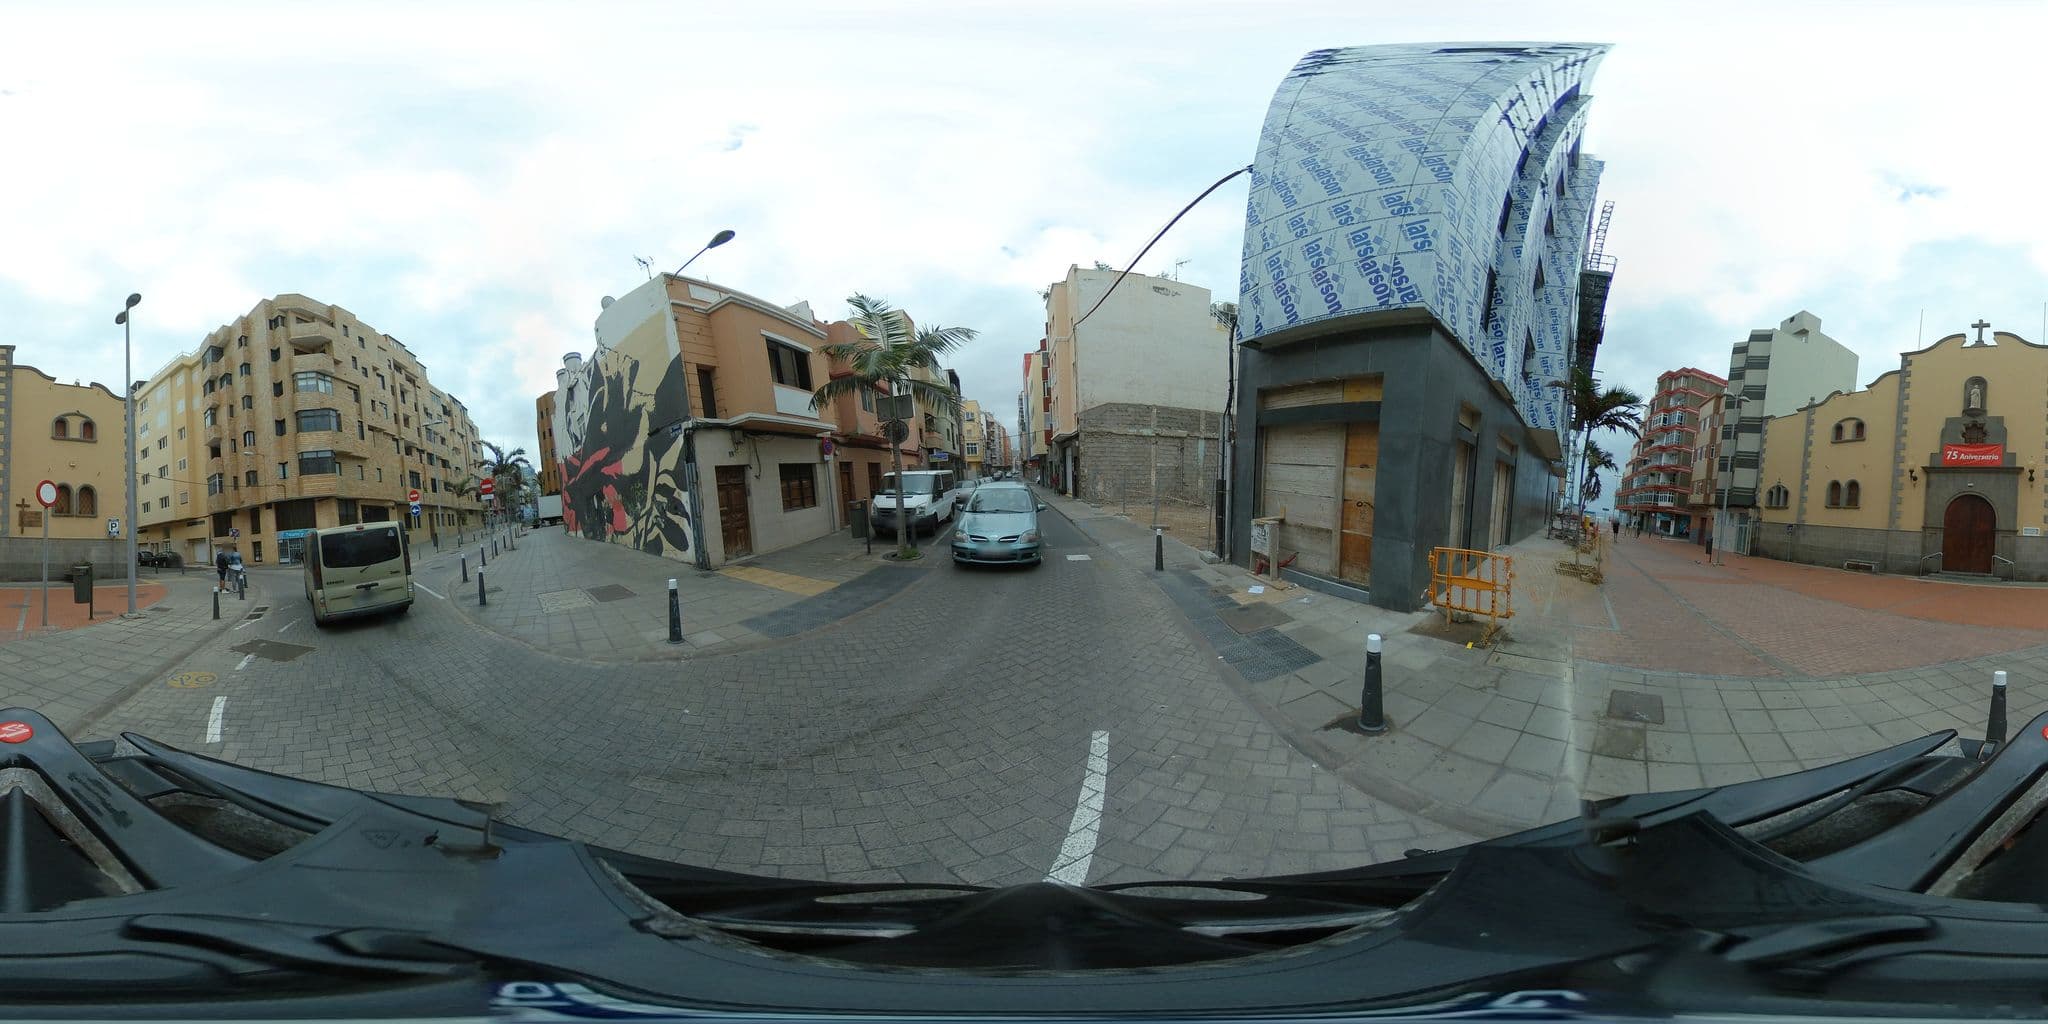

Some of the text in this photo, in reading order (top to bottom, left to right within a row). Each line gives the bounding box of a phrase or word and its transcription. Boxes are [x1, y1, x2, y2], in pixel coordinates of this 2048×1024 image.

[1289, 212, 1308, 239] lars
[1332, 200, 1355, 226] lars
[1405, 219, 1432, 251] lars
[1312, 266, 1343, 315] larson
[1946, 450, 1959, 460] 75
[110, 523, 117, 531] P
